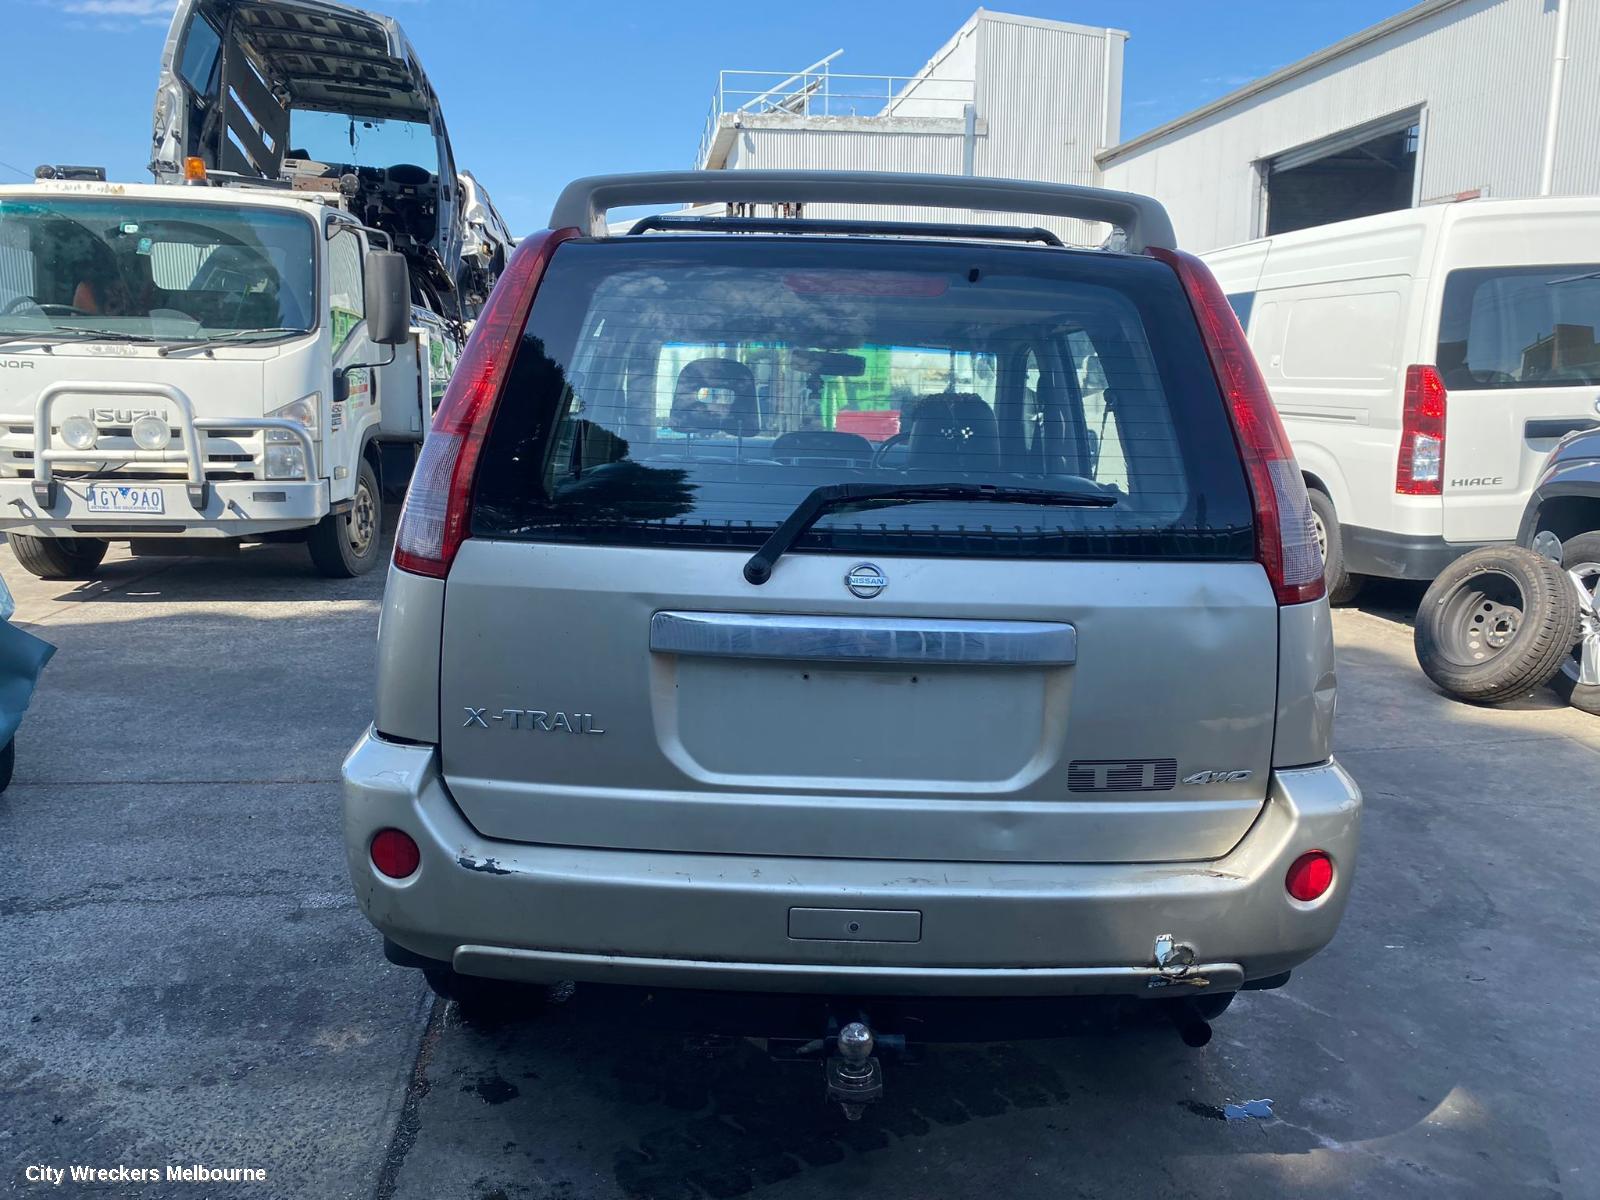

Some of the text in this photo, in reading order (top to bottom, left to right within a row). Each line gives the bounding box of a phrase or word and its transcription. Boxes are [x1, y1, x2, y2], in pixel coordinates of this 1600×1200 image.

[89, 408, 168, 423] ISUZU
[1451, 476, 1503, 487] HIACE
[850, 577, 884, 585] NISSAN
[463, 706, 605, 734] X-TRAIL
[1182, 769, 1253, 785] 4WD
